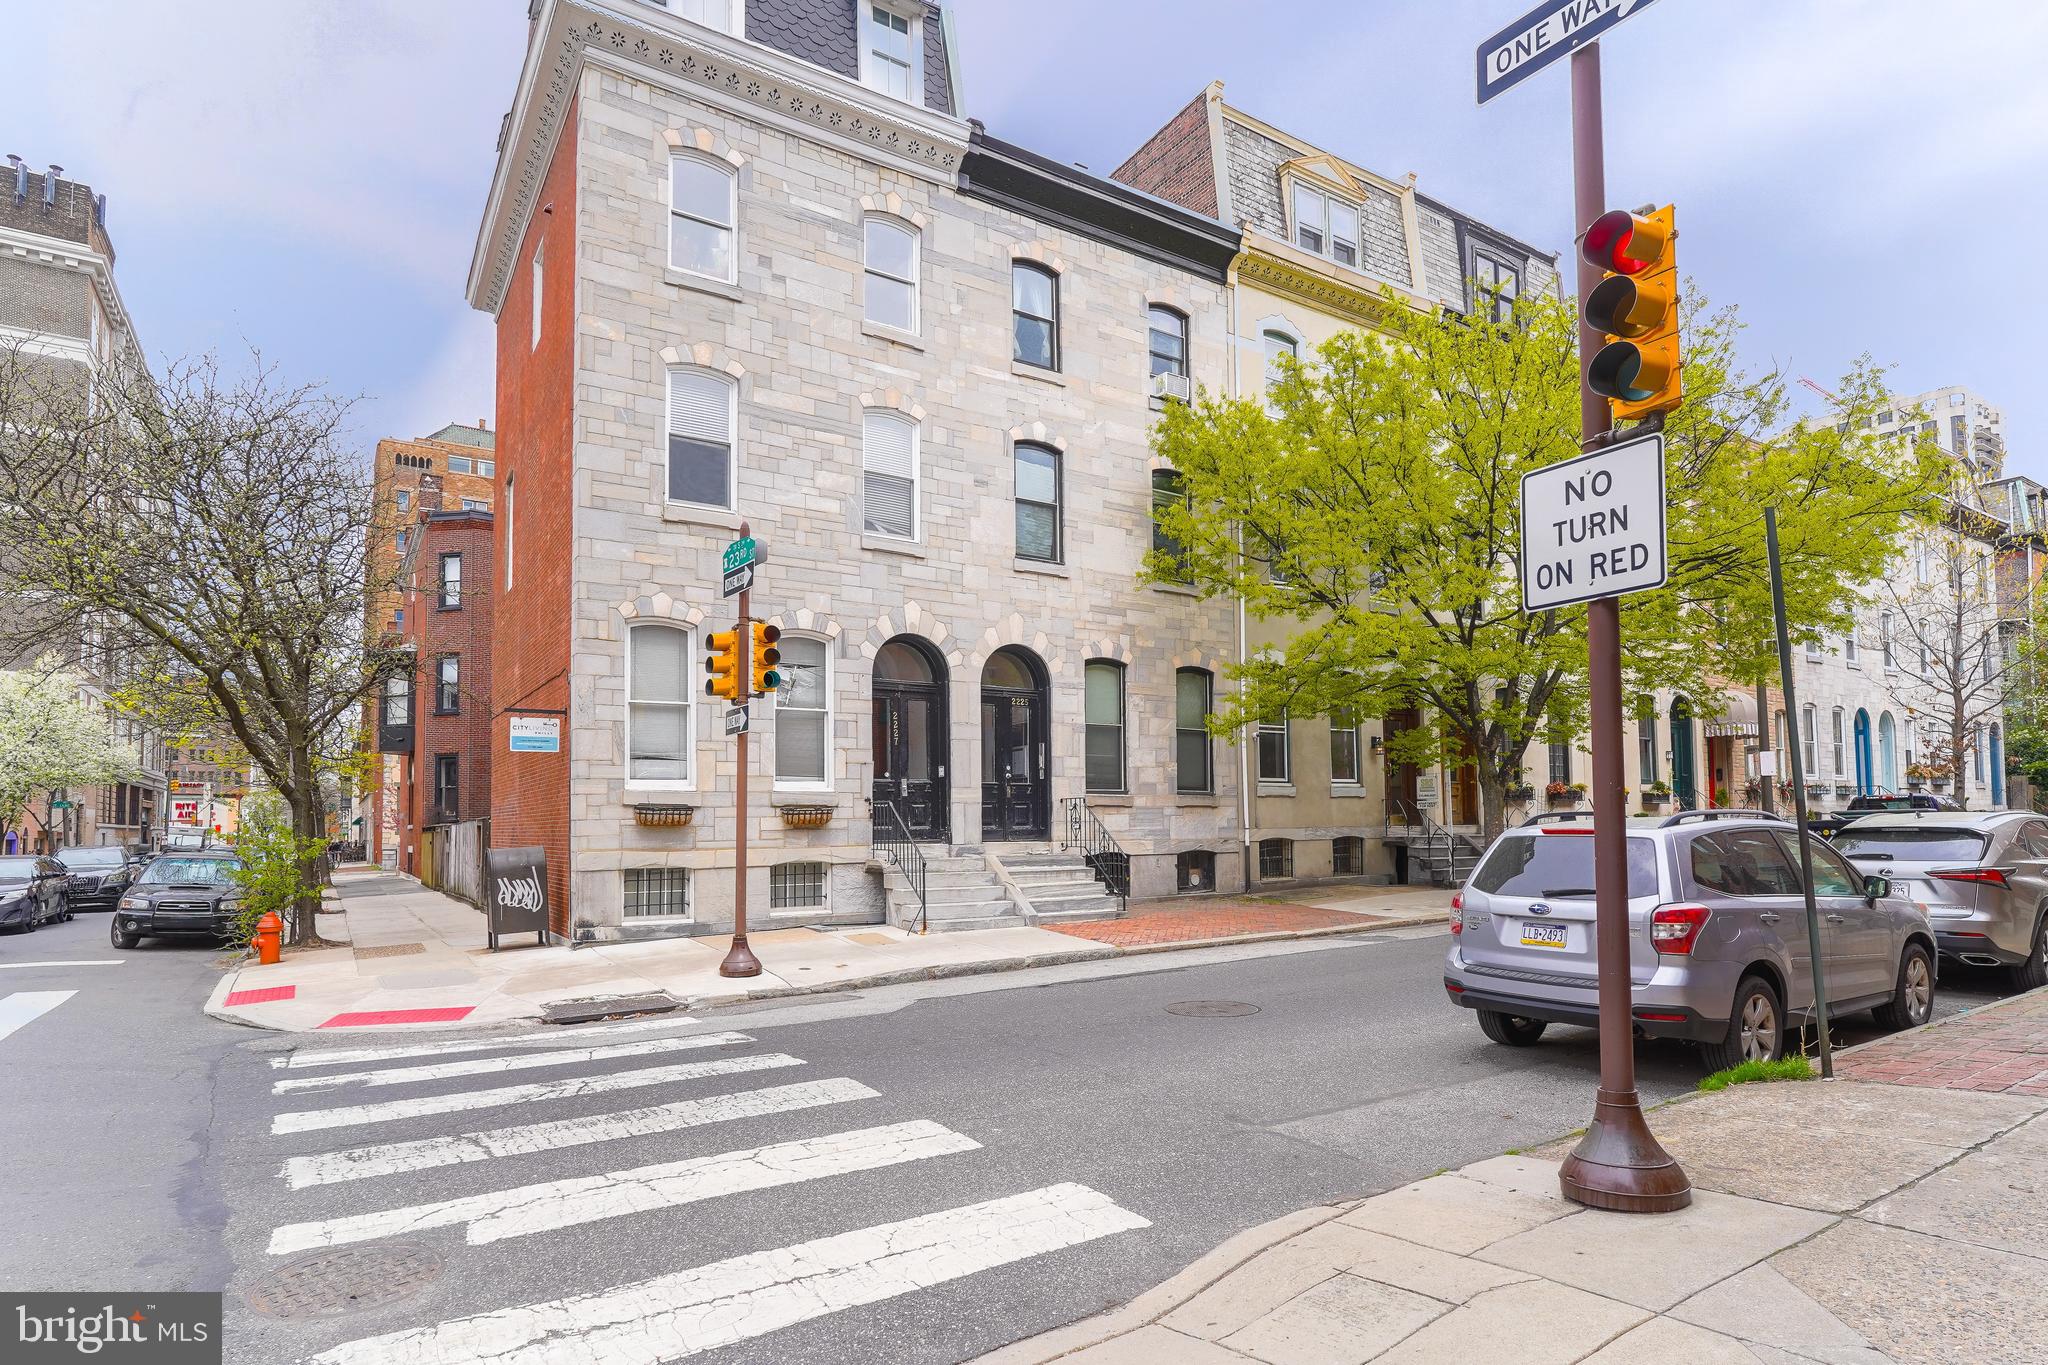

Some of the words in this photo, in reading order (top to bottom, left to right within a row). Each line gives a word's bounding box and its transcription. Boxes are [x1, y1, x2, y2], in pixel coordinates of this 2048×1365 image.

[1496, 21, 1551, 73] ONE
[1565, 470, 1612, 506] NO
[1553, 505, 1628, 547] TURN
[725, 577, 737, 591] ONE
[1537, 559, 1573, 590] ON
[1590, 543, 1649, 580] RED
[1012, 698, 1029, 706] 2225
[727, 716, 735, 729] ONE
